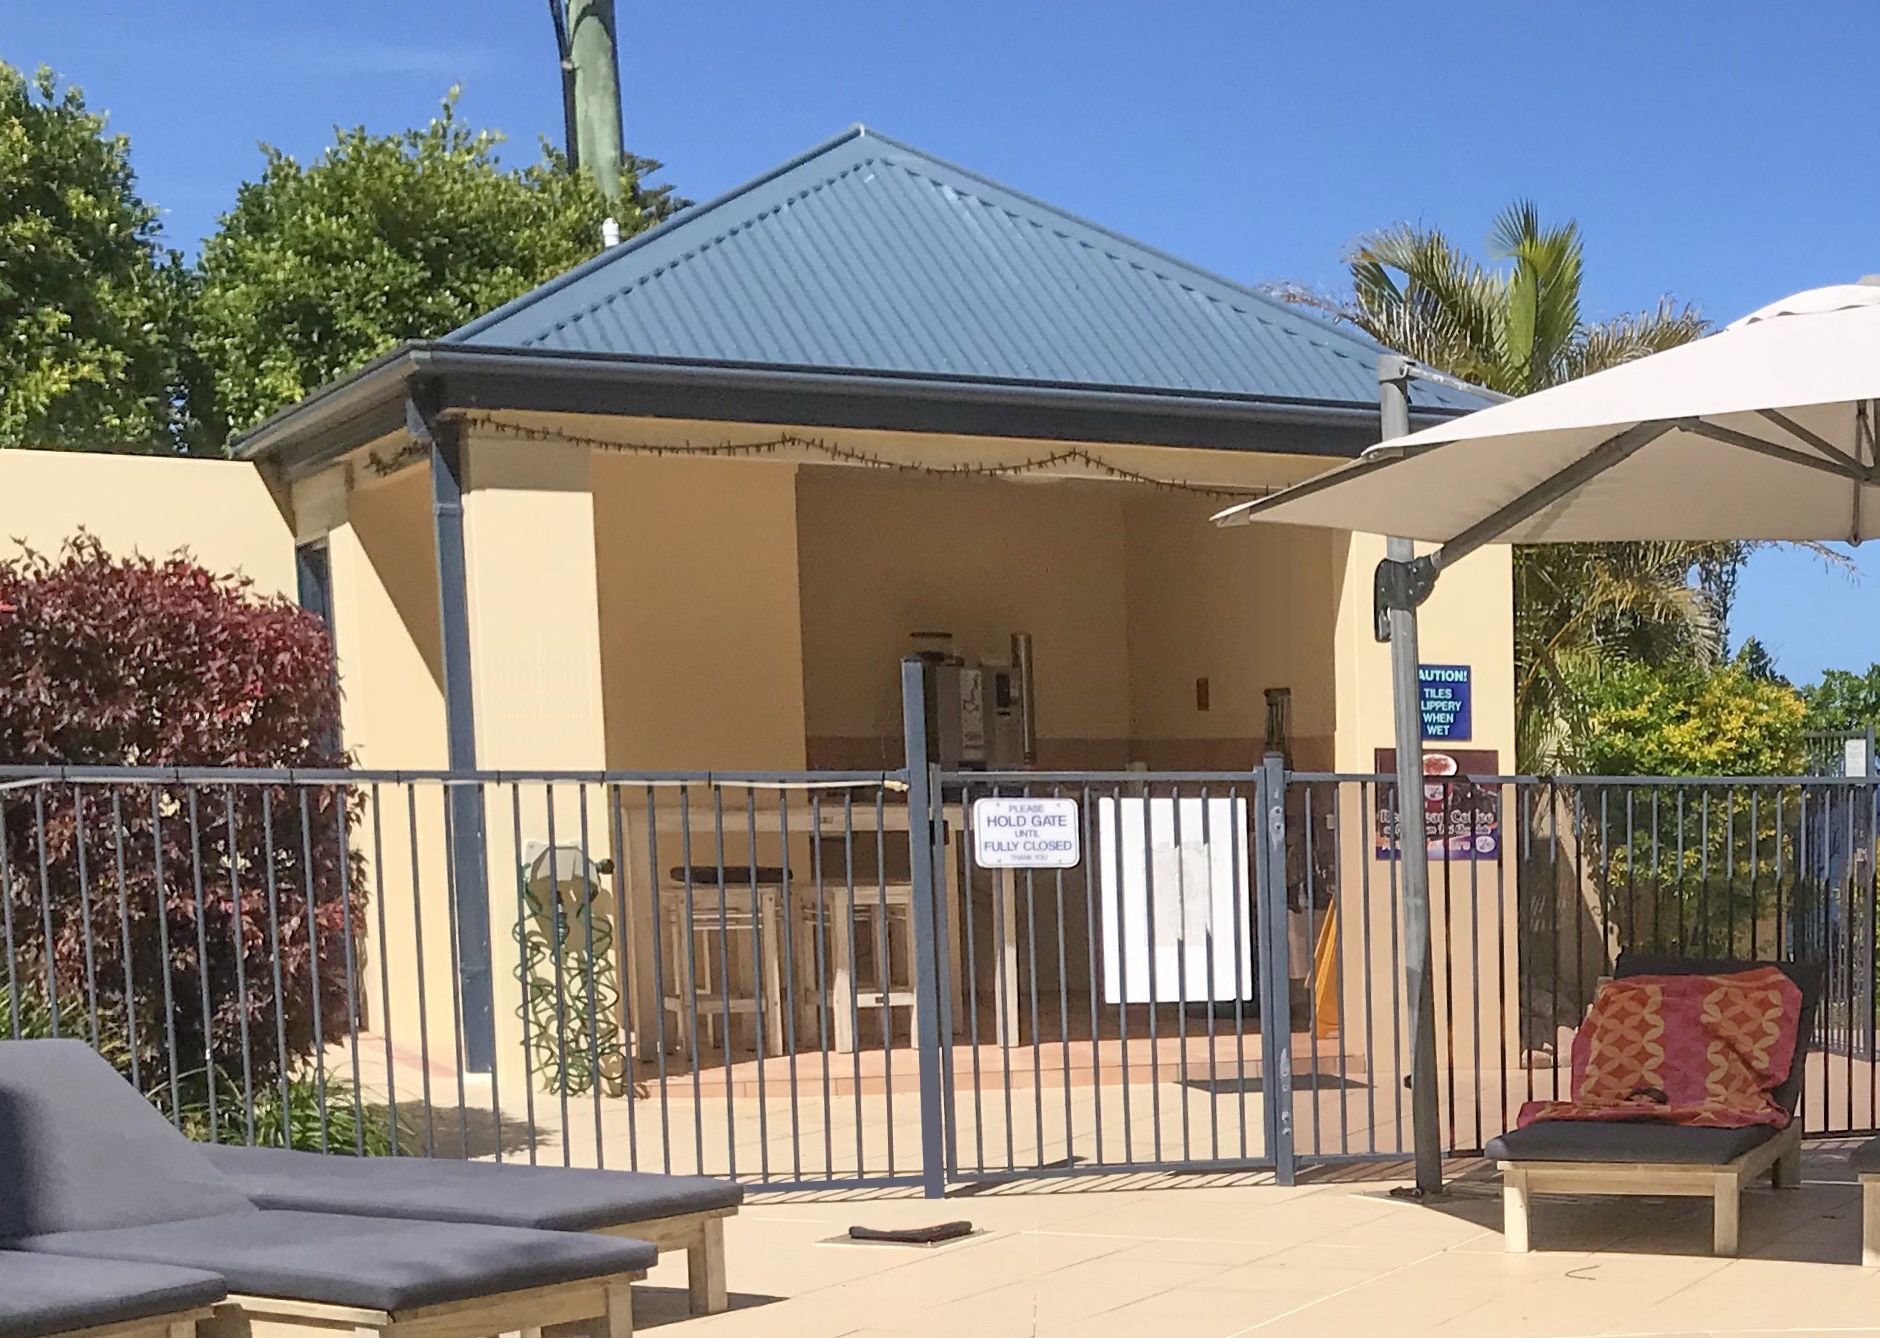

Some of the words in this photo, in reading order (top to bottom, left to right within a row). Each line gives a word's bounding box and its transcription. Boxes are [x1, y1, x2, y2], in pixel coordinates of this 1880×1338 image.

[1418, 669, 1468, 682] AUTION!
[1423, 688, 1453, 699] TILES
[1420, 700, 1462, 711] LIPPERY
[1422, 712, 1455, 723] WHEN
[1426, 724, 1451, 736] WET
[1008, 804, 1045, 813] PLEASE
[986, 815, 1027, 828] HOLD
[1031, 815, 1068, 827] GATE
[1014, 829, 1040, 838] UNTIL
[984, 841, 1020, 852] FULLY
[1023, 840, 1073, 852] CLOSED
